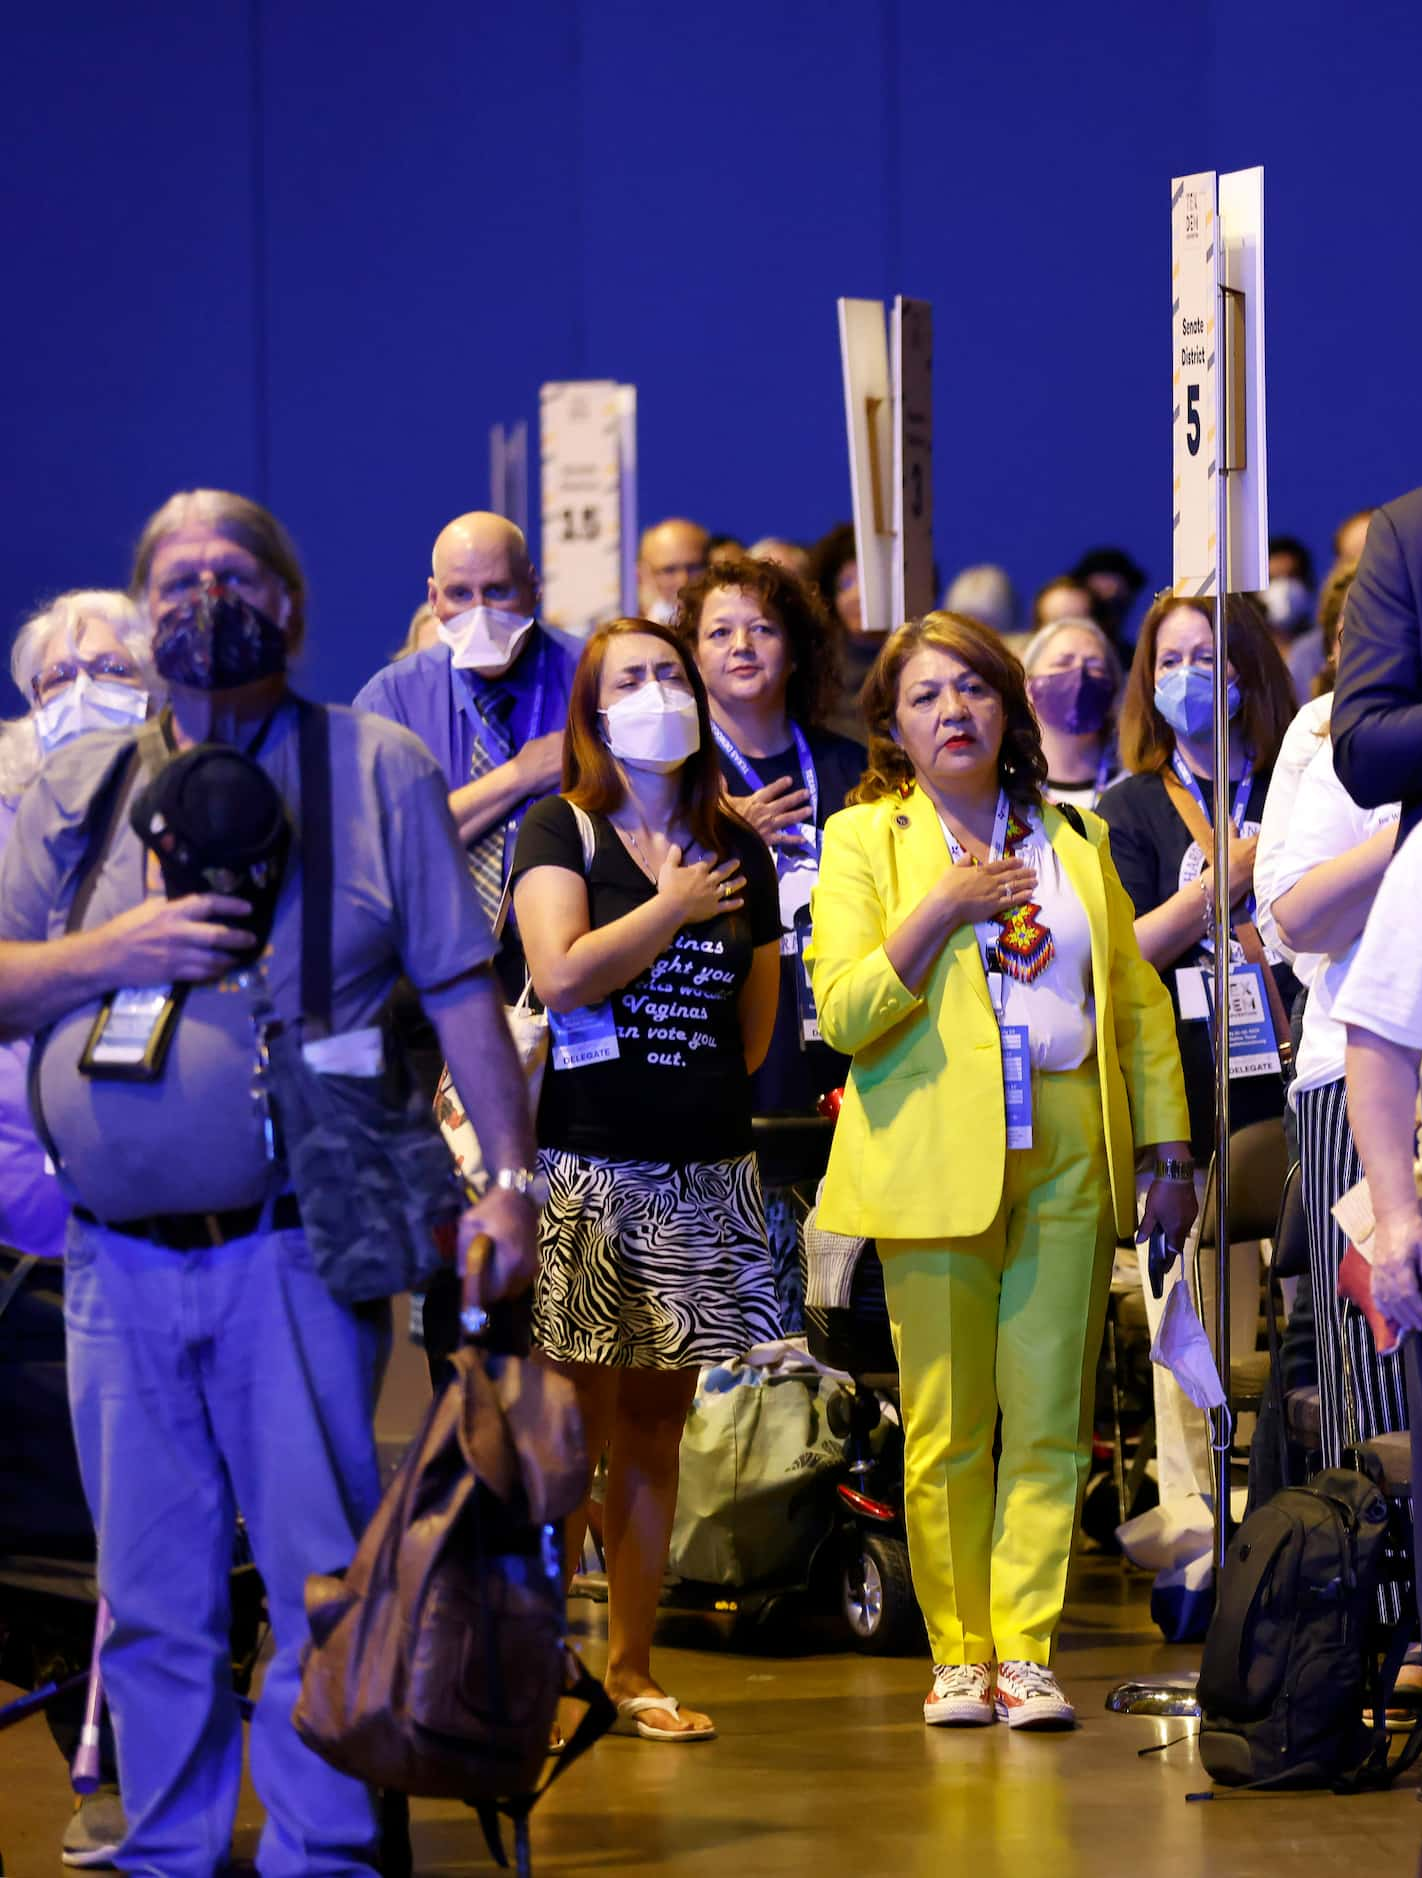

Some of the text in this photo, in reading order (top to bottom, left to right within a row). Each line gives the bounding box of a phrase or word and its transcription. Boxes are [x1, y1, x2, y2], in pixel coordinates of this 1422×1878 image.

[1182, 317, 1204, 336] Senate
[1181, 345, 1206, 367] District
[1187, 384, 1201, 456] 5
[693, 966, 735, 986] you
[622, 994, 708, 1022] Vaginas
[647, 1027, 687, 1041] vote
[688, 1032, 717, 1050] you
[564, 1048, 610, 1065] DELEGATE
[647, 1052, 687, 1067] out.
